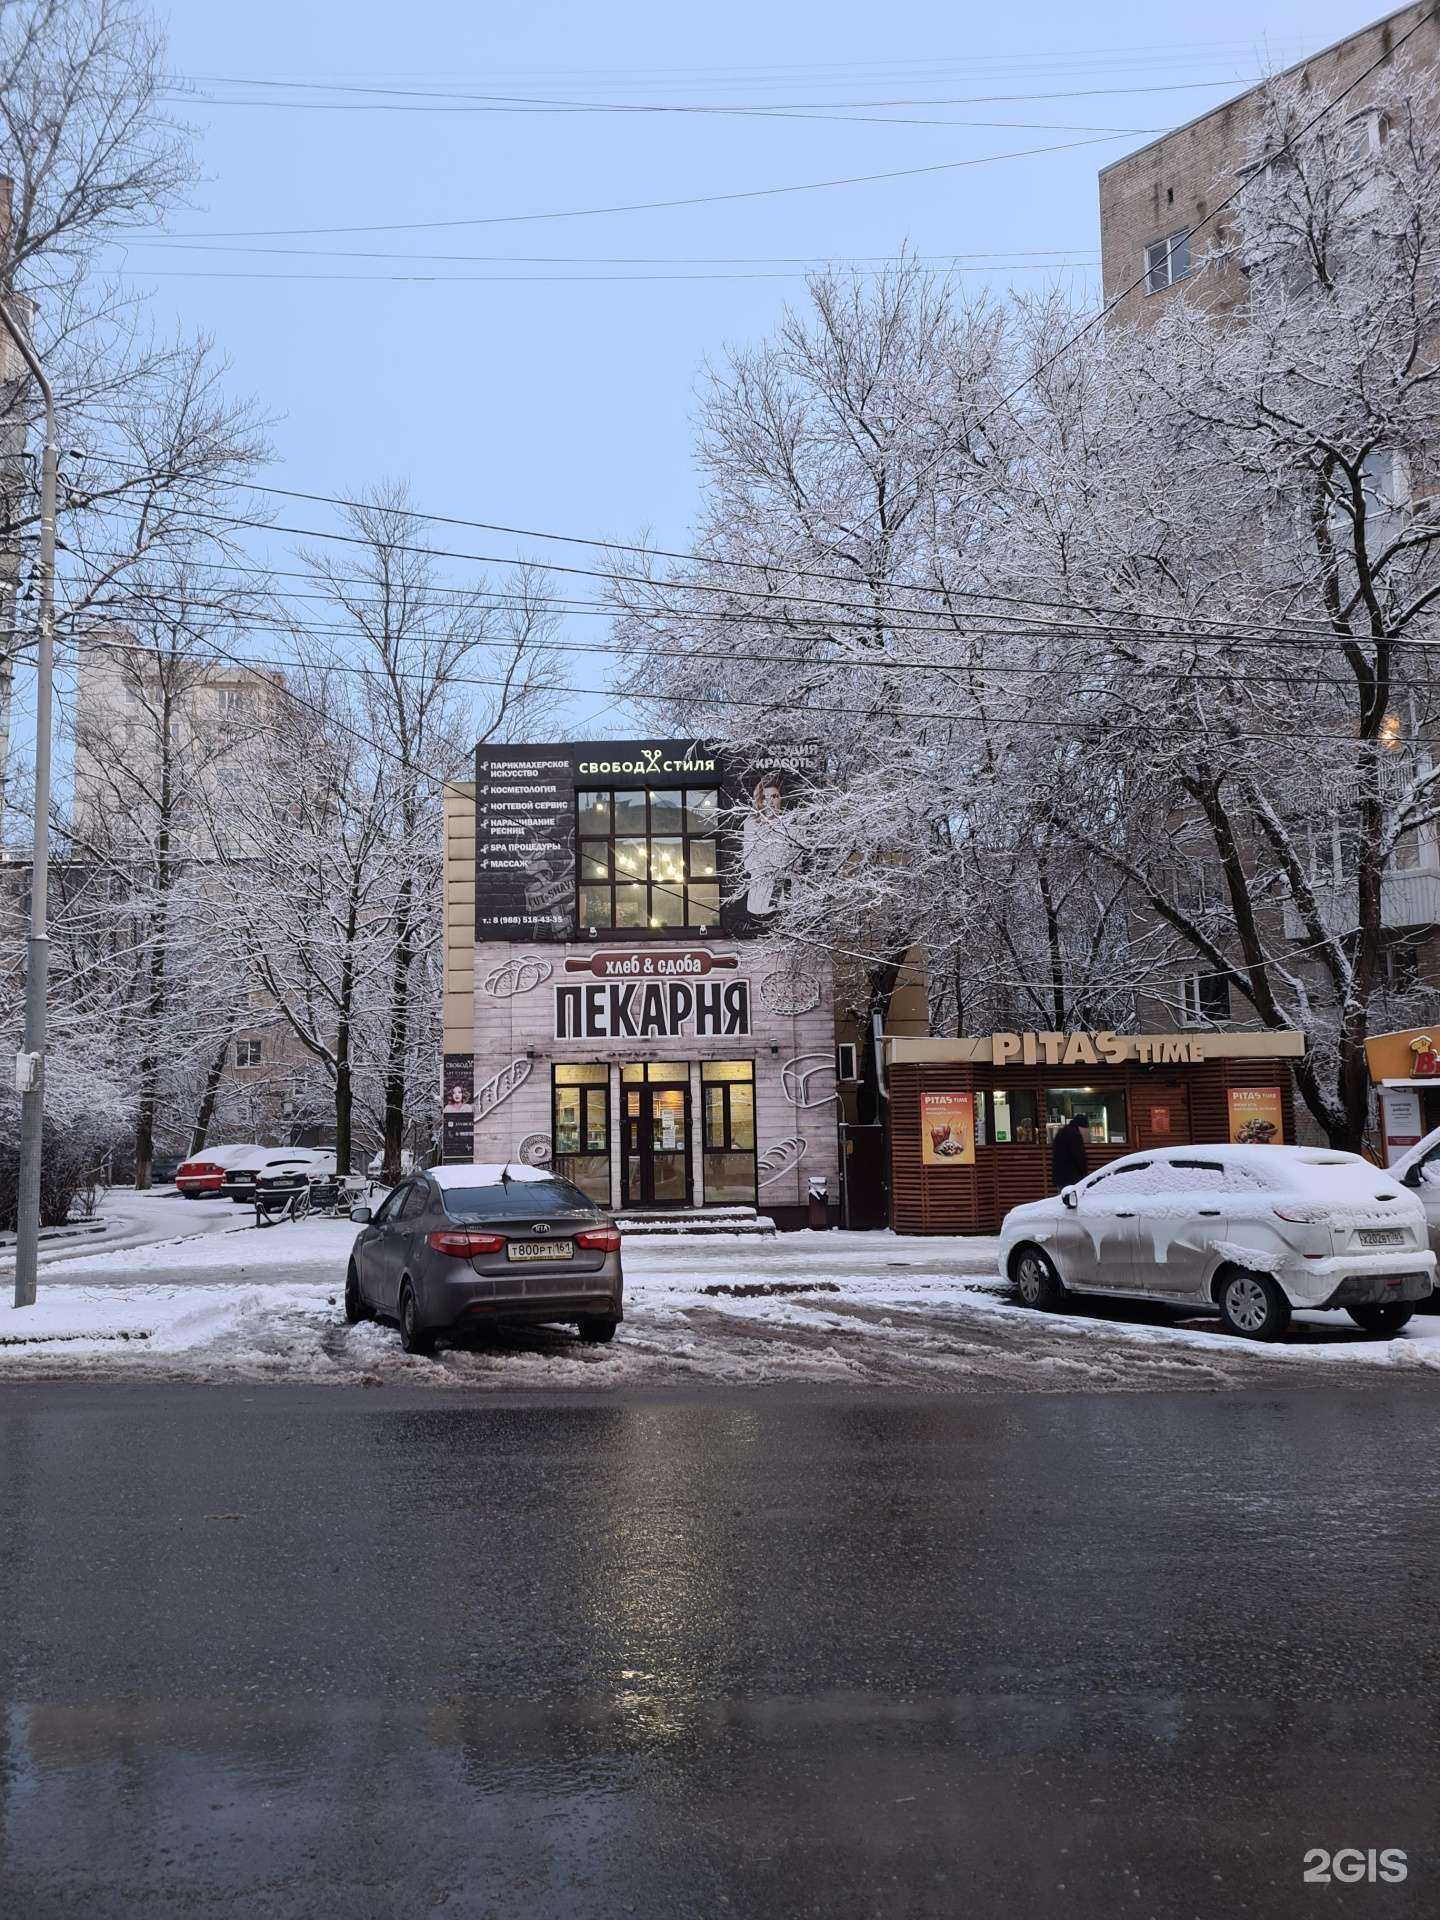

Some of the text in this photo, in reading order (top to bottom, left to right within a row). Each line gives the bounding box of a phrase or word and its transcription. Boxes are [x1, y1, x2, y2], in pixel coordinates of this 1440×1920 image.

[490, 761, 569, 769] ПАРИКМАХЕРСКОЕ
[663, 760, 715, 771] СТИЛЯ
[490, 786, 556, 794] КОСМЕТОЛОГИЯ
[490, 801, 568, 810] НОГТЕВОЙ СЕРВИС
[508, 843, 561, 851] ПРОЦЕДУРЫ
[490, 860, 529, 868] МАССАЖ
[605, 954, 702, 975] хлеб & сдоба
[556, 981, 749, 1039] ПЕКАРНЯ
[1135, 1039, 1205, 1063] TIME
